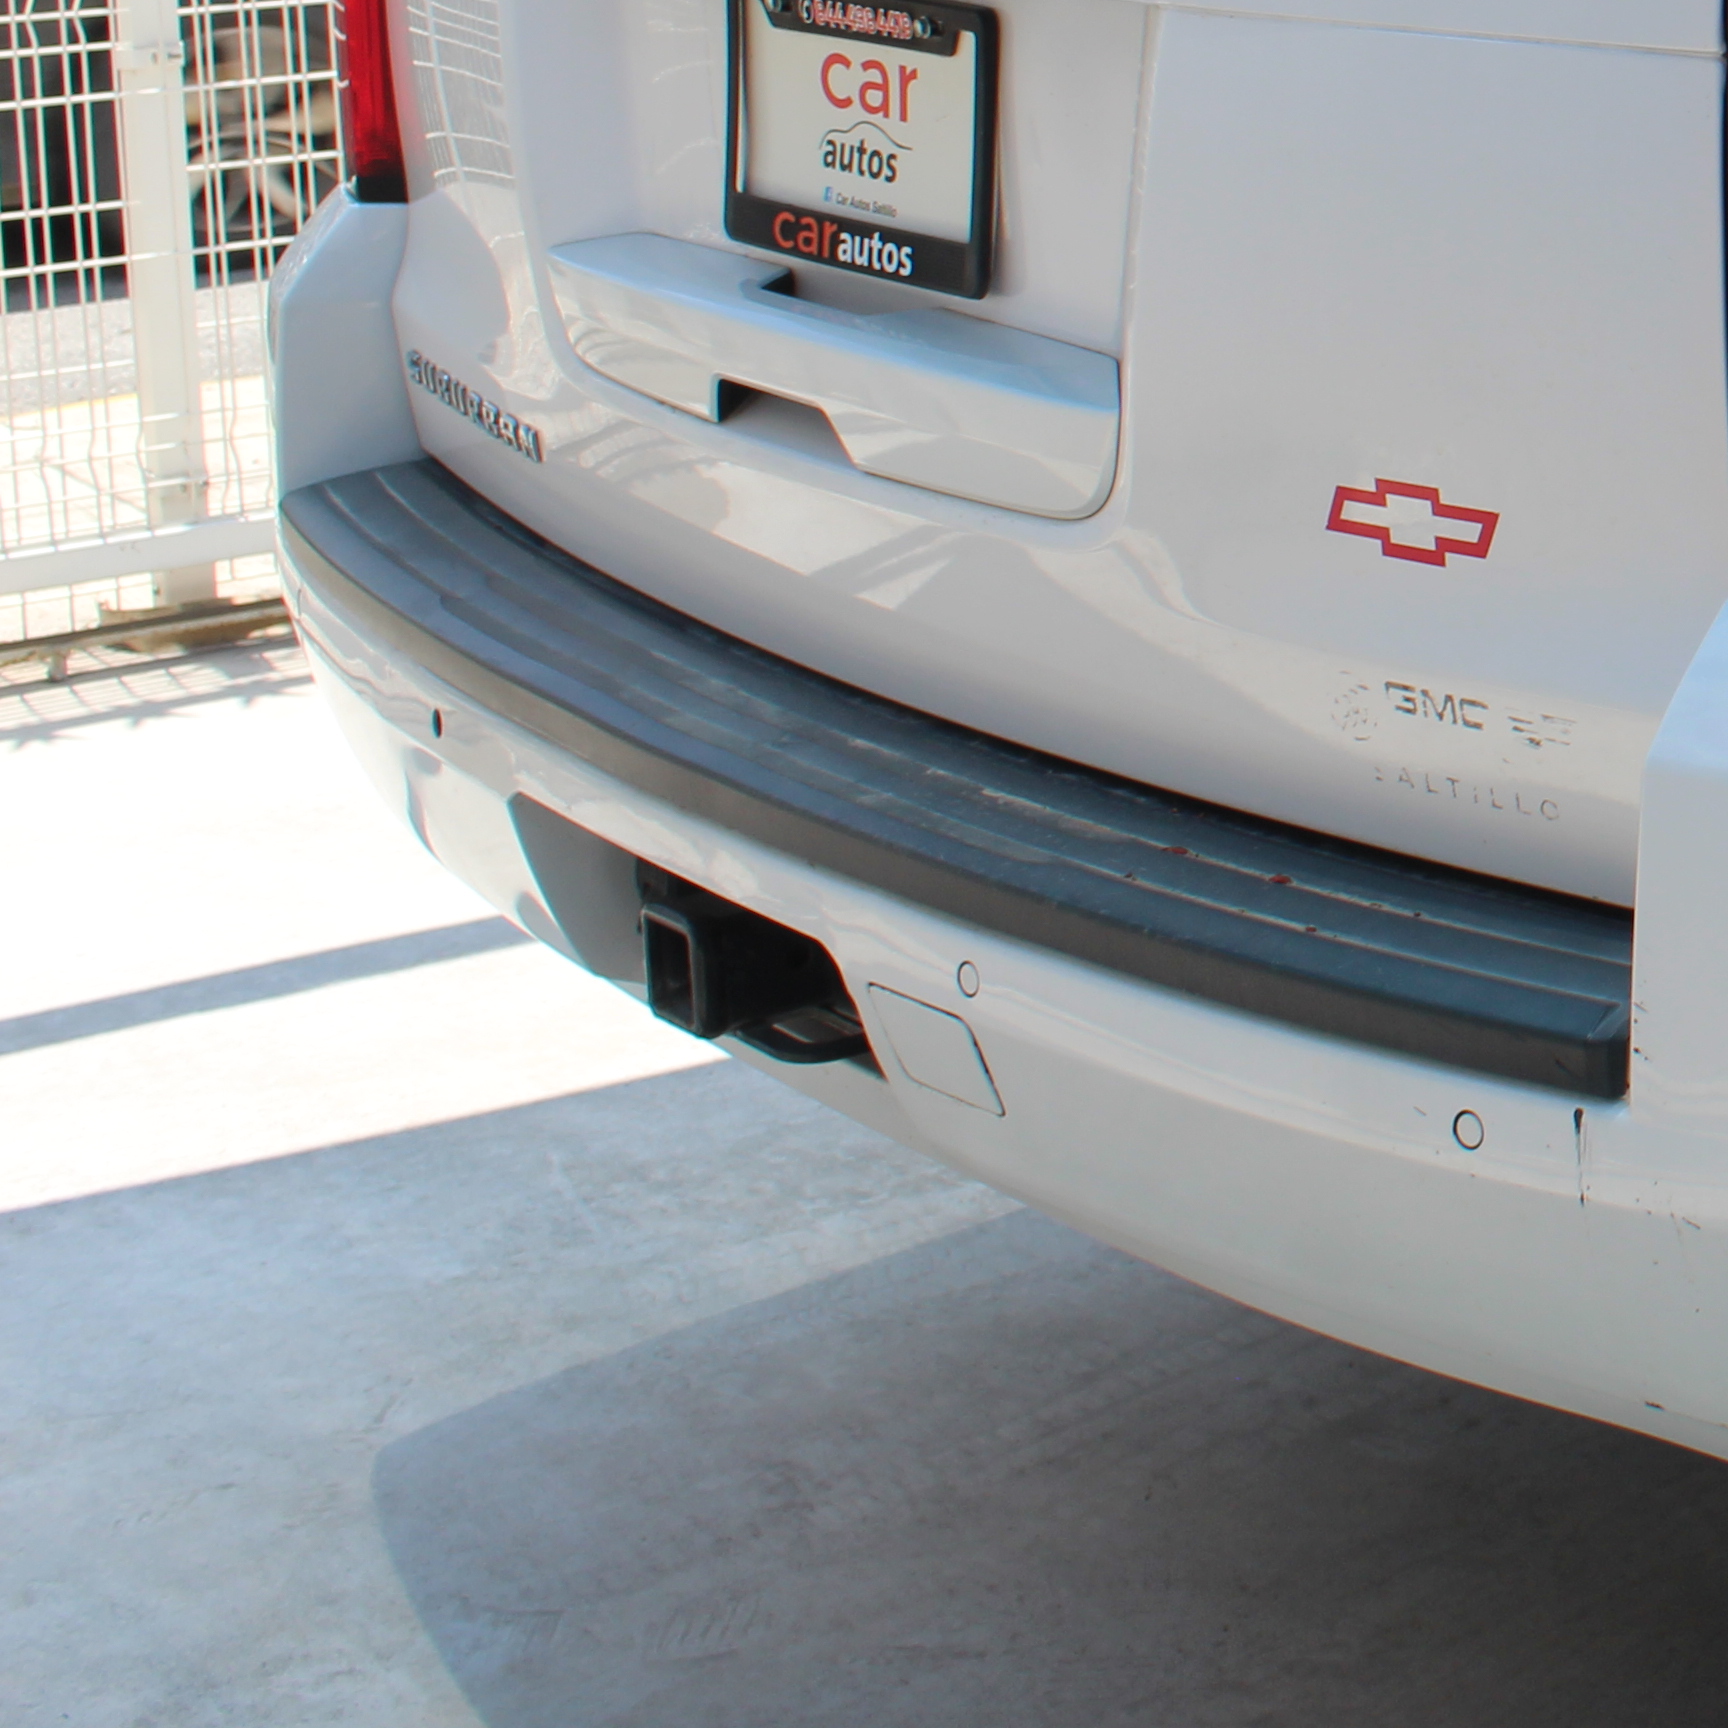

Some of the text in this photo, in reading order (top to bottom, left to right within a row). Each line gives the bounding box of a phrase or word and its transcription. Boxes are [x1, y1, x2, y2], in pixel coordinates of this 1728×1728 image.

[820, 52, 919, 123] car
[822, 138, 899, 183] autos
[1384, 680, 1490, 731] GMC
